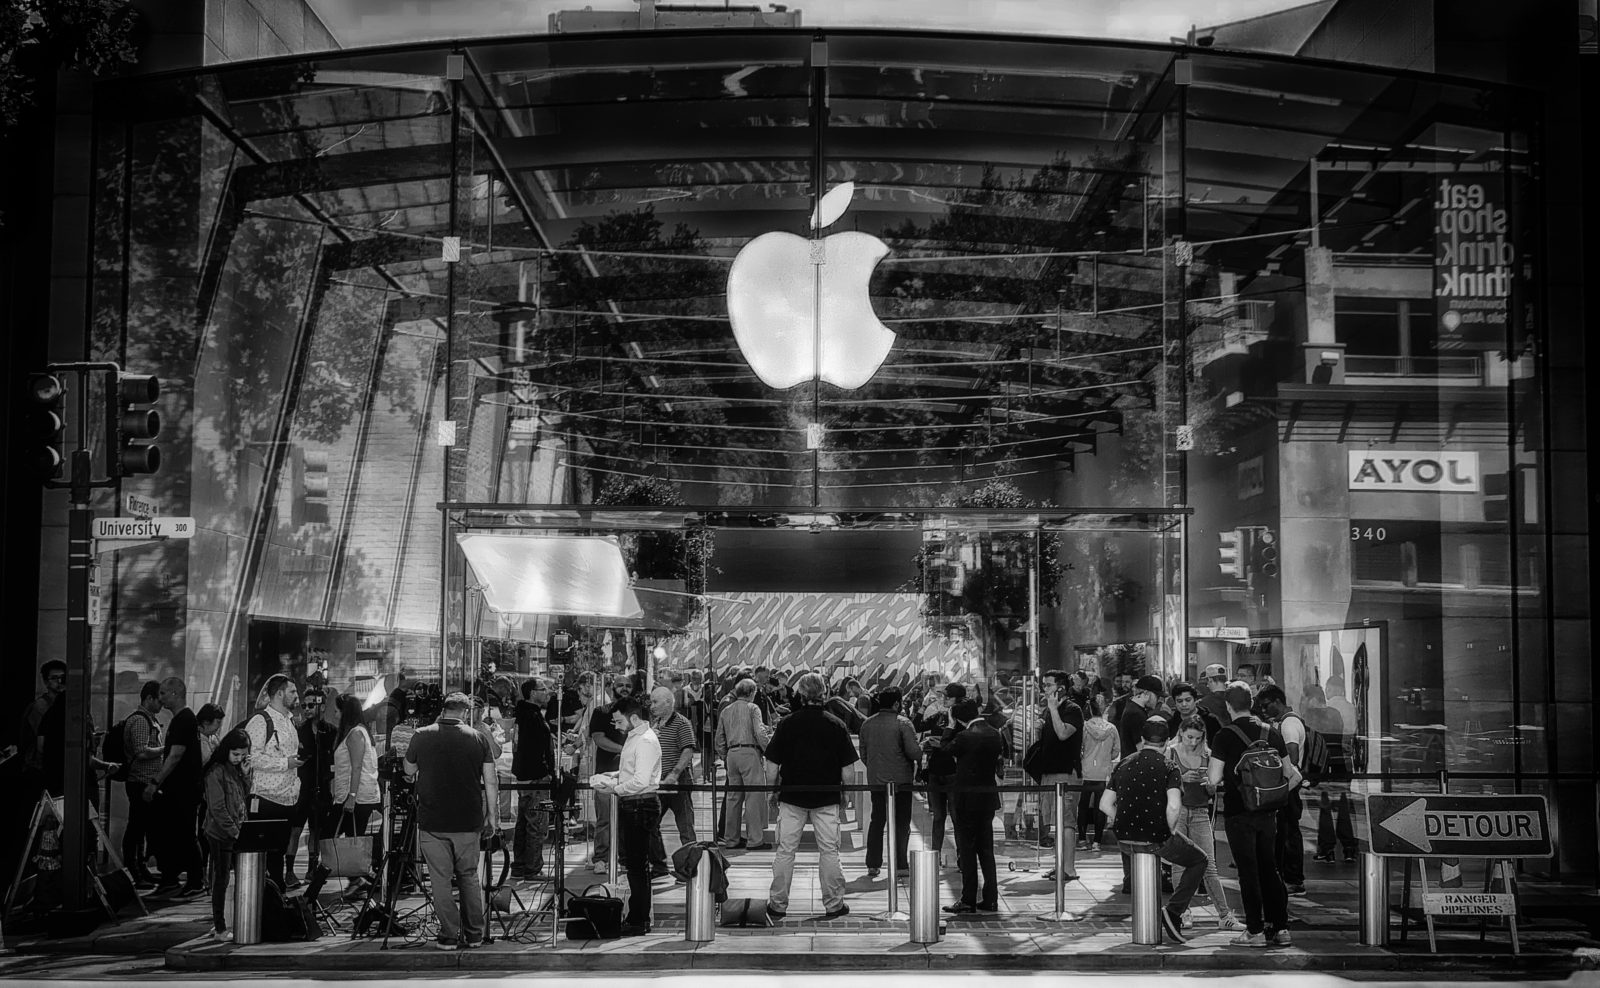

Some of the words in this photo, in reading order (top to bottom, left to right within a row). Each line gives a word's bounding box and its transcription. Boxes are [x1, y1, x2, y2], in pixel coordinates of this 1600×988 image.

[100, 521, 161, 537] University
[175, 523, 187, 532] 300
[1351, 527, 1386, 541] 340
[1424, 814, 1533, 837] DETOUR
[1445, 895, 1497, 904] RANGER
[1441, 905, 1503, 914] PIPELINES
